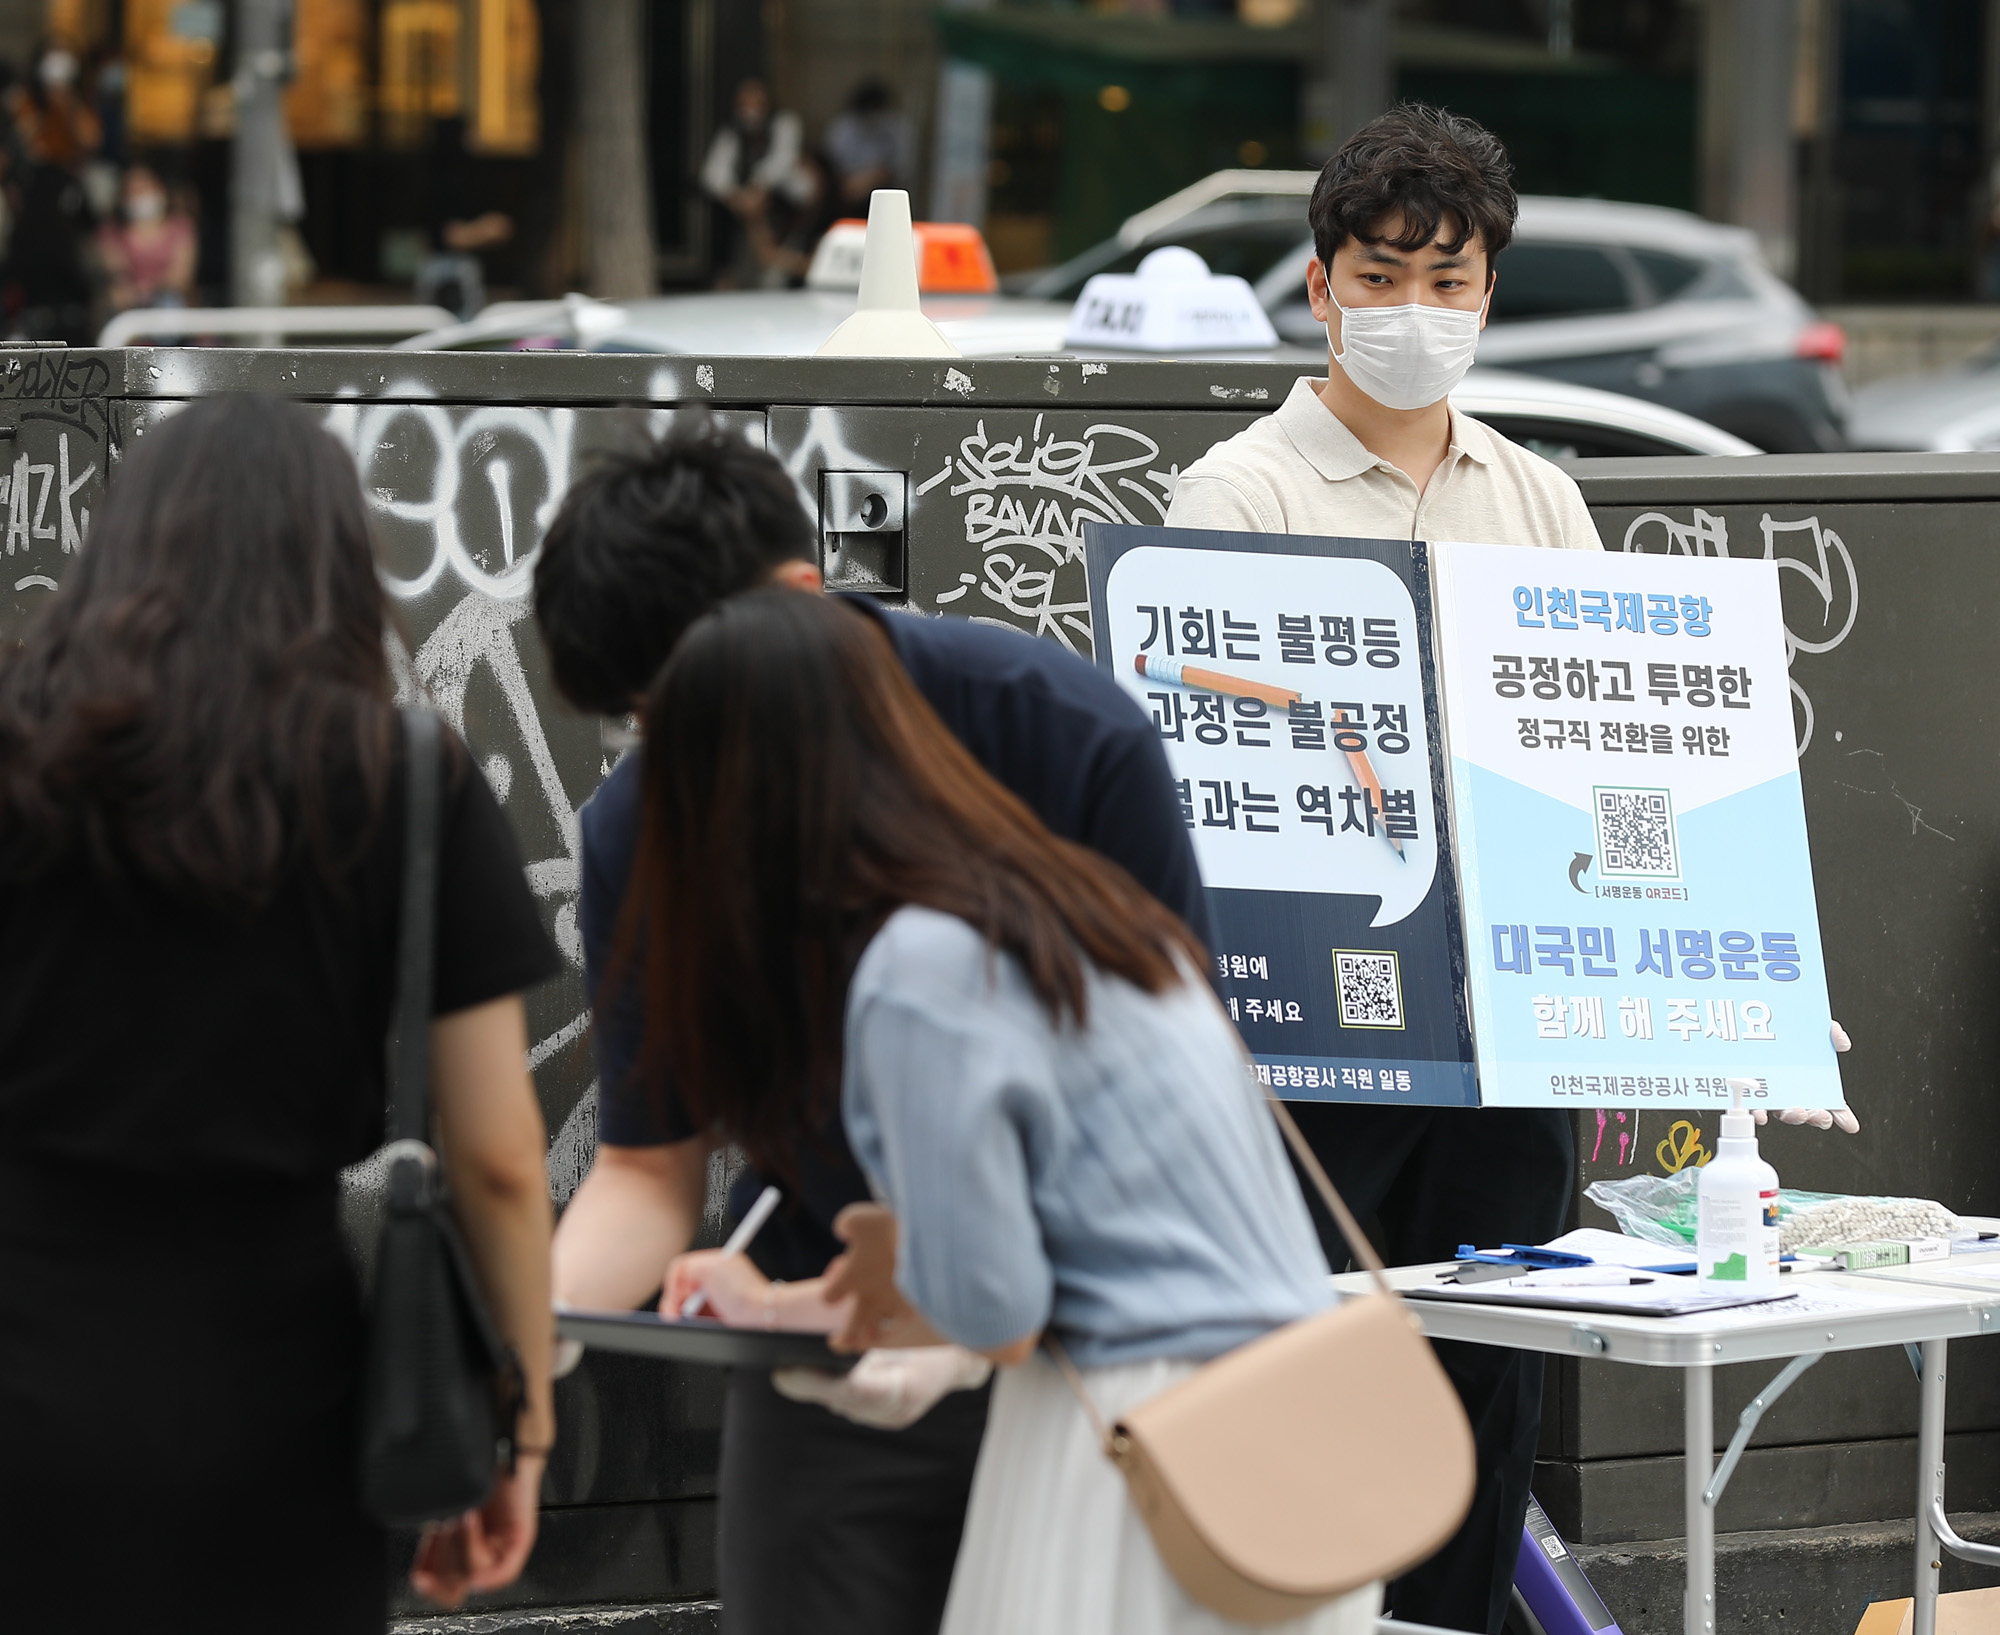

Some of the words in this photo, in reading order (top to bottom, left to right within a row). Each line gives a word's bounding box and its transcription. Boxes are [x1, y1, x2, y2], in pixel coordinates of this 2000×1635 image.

[1136, 605, 1260, 661] 기회는
[1278, 613, 1400, 668] 불평등
[1512, 584, 1713, 637] 인천국제공항
[1492, 654, 1634, 701] 공정하고
[1647, 661, 1752, 709] 투명한
[1147, 692, 1271, 747] 과정은
[1288, 699, 1410, 754] 불공정
[1516, 717, 1591, 751] 정규직
[1600, 722, 1674, 755] 전환을
[1682, 725, 1730, 757] 위한
[1296, 784, 1419, 840] 역차별
[1491, 923, 1618, 977] 대국민
[1635, 928, 1801, 982] 서명운동
[1245, 998, 1304, 1023] 주세요
[1531, 993, 1606, 1040] 함께
[1617, 995, 1654, 1041] 해
[1667, 997, 1776, 1042] 주세요
[1341, 1068, 1374, 1090] 직원
[1379, 1069, 1412, 1092] 일동
[1550, 1075, 1689, 1098] 인천국제공항공사
[1695, 1077, 1729, 1098] 직원
